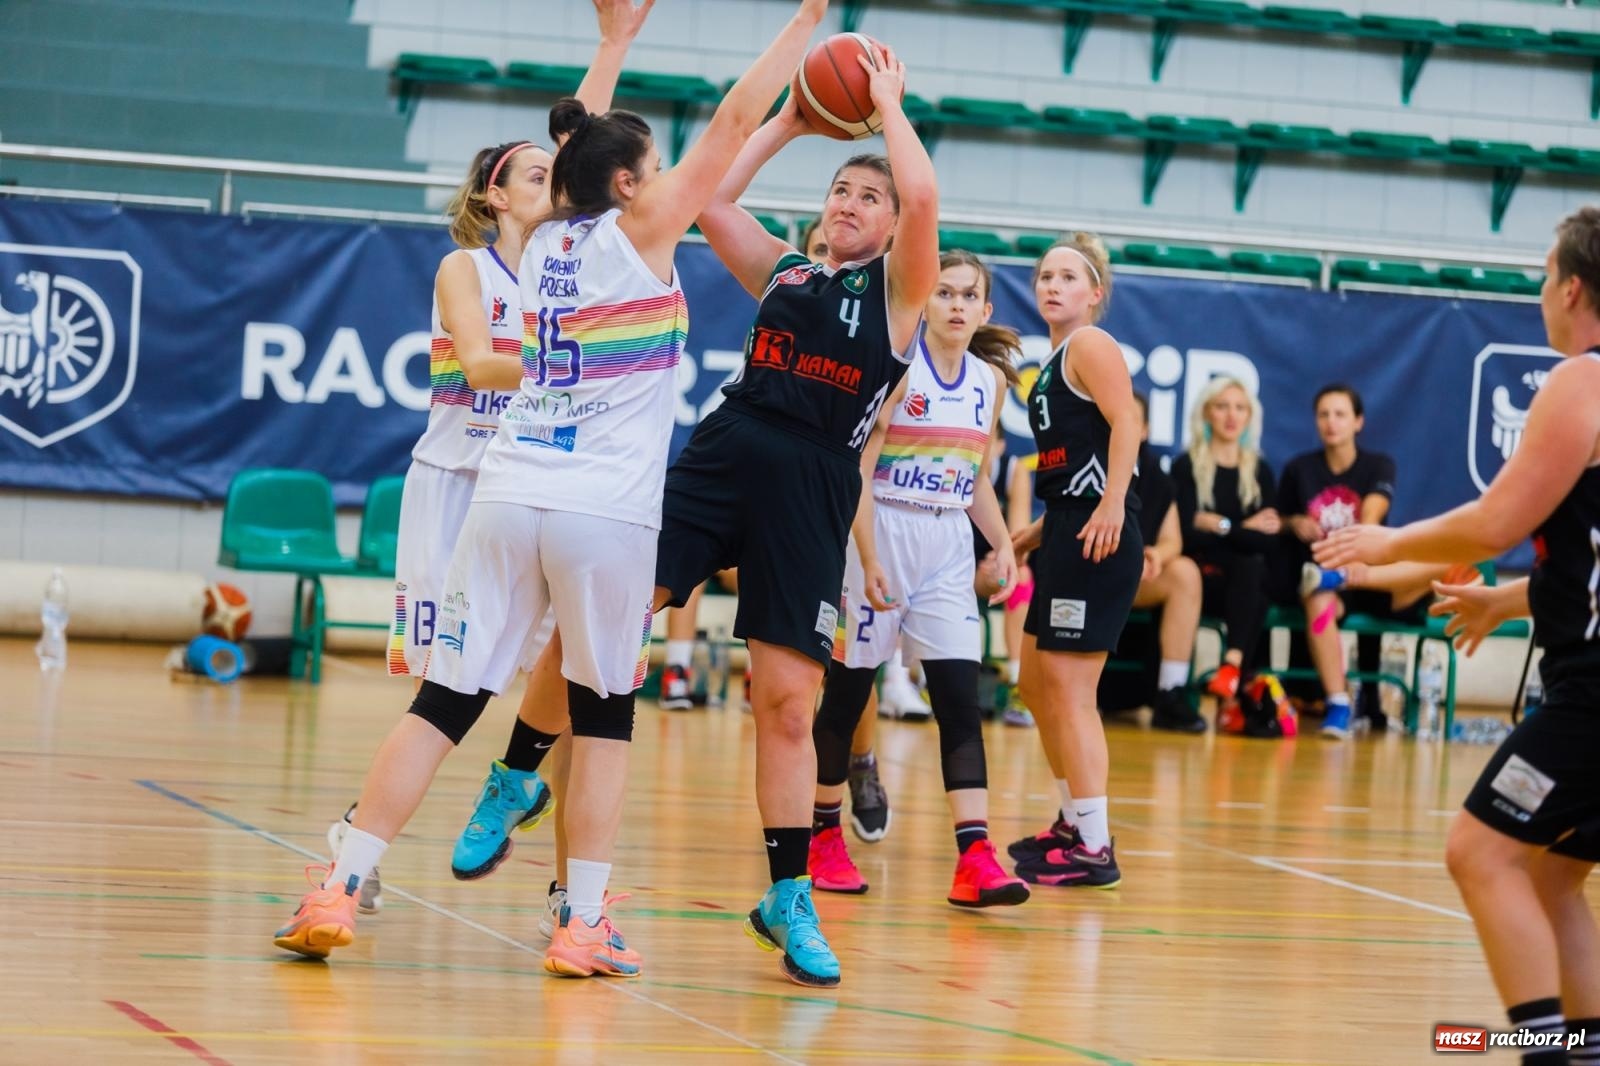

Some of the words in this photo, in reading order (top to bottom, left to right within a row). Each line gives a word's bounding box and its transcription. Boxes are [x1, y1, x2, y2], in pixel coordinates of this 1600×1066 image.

[839, 298, 860, 338] 4
[535, 307, 581, 387] 15
[796, 353, 862, 388] KAMAN
[974, 387, 984, 426] 2
[1036, 394, 1051, 431] 3
[893, 466, 974, 501] uks2kp
[414, 601, 436, 645] 13
[857, 605, 875, 643] 2
